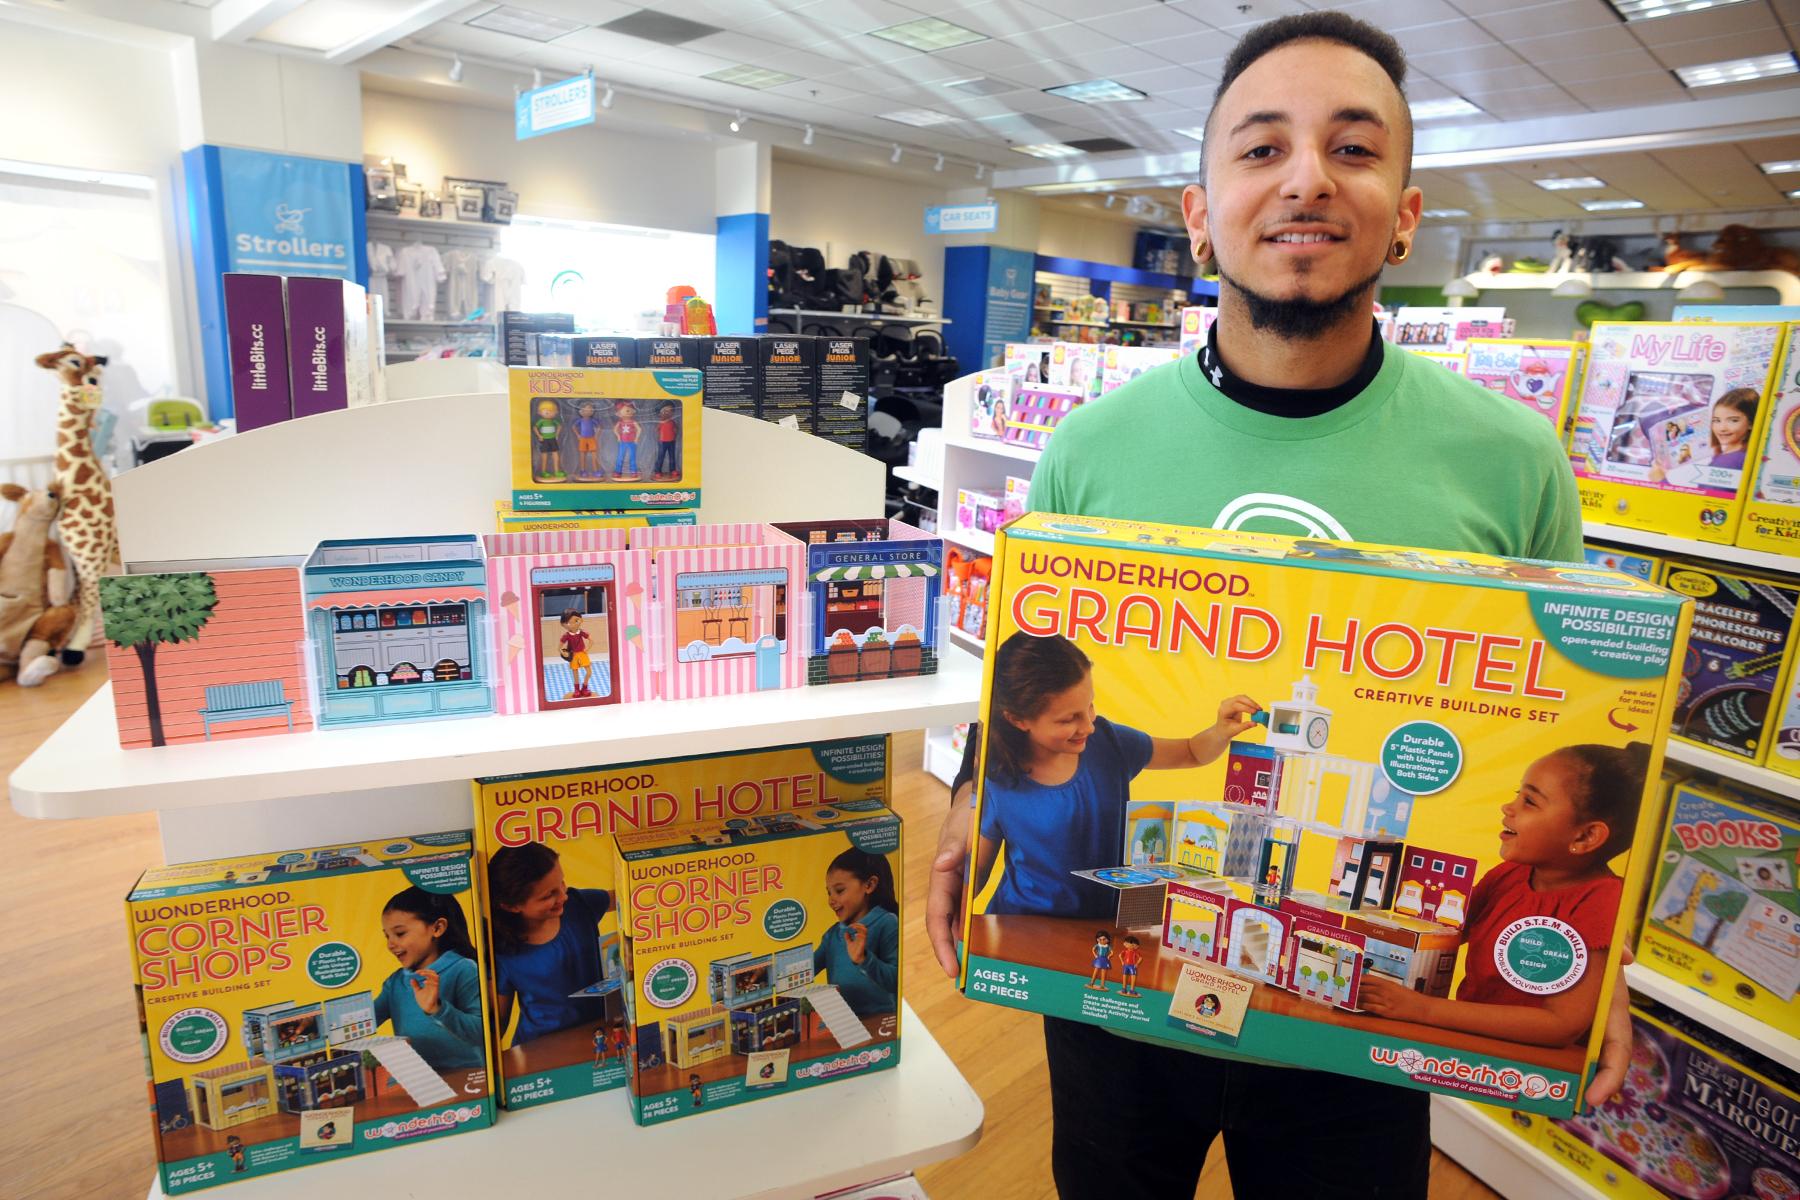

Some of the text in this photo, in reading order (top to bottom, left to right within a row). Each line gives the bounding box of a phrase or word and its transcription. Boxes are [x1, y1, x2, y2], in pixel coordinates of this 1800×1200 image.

[534, 84, 588, 113] STROLLERS
[943, 210, 992, 222] CAR SEATS
[236, 232, 346, 259] Strollers
[250, 323, 268, 390] littleBits.cc
[311, 325, 328, 392] littleBits.cc
[711, 355, 743, 363] JUNIOR
[770, 355, 801, 363] JUNIOR
[826, 354, 856, 362] JUNIOR
[1631, 334, 1671, 366] My
[1671, 335, 1727, 363] Life
[586, 355, 621, 364] JUNIOR
[650, 355, 683, 364] JUNIOR
[529, 379, 575, 394] KIDS
[835, 551, 921, 563] GENERAL STORE
[329, 572, 465, 588] WONDERHOOD CANDY
[1019, 552, 1251, 597] WONDERHOOD
[1544, 602, 1675, 627] INFINITE DESIGN
[1696, 602, 1758, 623] RACELETS
[1561, 618, 1671, 640] POSSIBILITIES!
[1694, 614, 1782, 641] PHORESCENTS
[1010, 583, 1567, 701] GRAND HOTEL
[1561, 636, 1669, 656] open-ended building
[1644, 655, 1668, 666] play
[1708, 660, 1719, 670] 6
[1354, 687, 1559, 724] CREATIVE BUILDING SET
[1403, 734, 1444, 747] Durable
[821, 743, 884, 757] INFINITE DESIGN
[831, 752, 884, 763] POSSIBILITIES!
[1400, 745, 1453, 758] Plastic Panels
[1390, 760, 1436, 772] Illustrations
[1416, 756, 1445, 765] Unique
[1397, 770, 1439, 781] Both Sides
[495, 774, 655, 806] WONDERHOOD
[494, 771, 840, 848] GRAND HOTEL
[1673, 819, 1782, 851] BOOKS
[410, 867, 439, 875] INFINITE
[632, 852, 755, 881] WONDERHOOD
[631, 864, 784, 912] CORNER
[1177, 888, 1216, 903] WONDERHOOD
[135, 891, 290, 923] WONDERHOOD
[774, 906, 796, 914] Durable
[633, 898, 752, 942] SHOPS
[137, 906, 329, 957] CORNER
[1307, 926, 1351, 942] GRAND HOTEL
[636, 944, 676, 955] CREATIVE
[679, 937, 718, 947] BUILDING
[1499, 924, 1522, 946] BUILD
[1563, 929, 1584, 959] SKILLS
[319, 950, 346, 958] Durable
[1543, 950, 1569, 959] DREAM
[142, 943, 293, 991] SHOPS
[1520, 960, 1547, 968] DESIGN
[974, 968, 1028, 985] AGES 5+
[1186, 969, 1247, 991] WONDERHOOD
[1512, 977, 1543, 991] SOLVING
[1551, 963, 1582, 990] CREATIVITY
[147, 979, 271, 1005] CREATIVE BUILDING SET
[973, 982, 1029, 1001] 62 PIECES
[1191, 977, 1238, 995] GRAND HOTEL
[162, 1019, 175, 1038] BUILD
[510, 1077, 552, 1095] AGES 5+
[1414, 1074, 1431, 1083] build
[1438, 1080, 1459, 1089] world
[1469, 1086, 1514, 1099] possibilities
[511, 1088, 554, 1103] 62 PIECES
[643, 1096, 678, 1111] AGES 5+
[654, 1106, 679, 1118] PIECES
[1738, 1077, 1800, 1133] Hear
[1683, 1073, 1800, 1160] MARQUE
[169, 1162, 214, 1179] AGES 5+
[183, 1171, 215, 1185] PIECES
